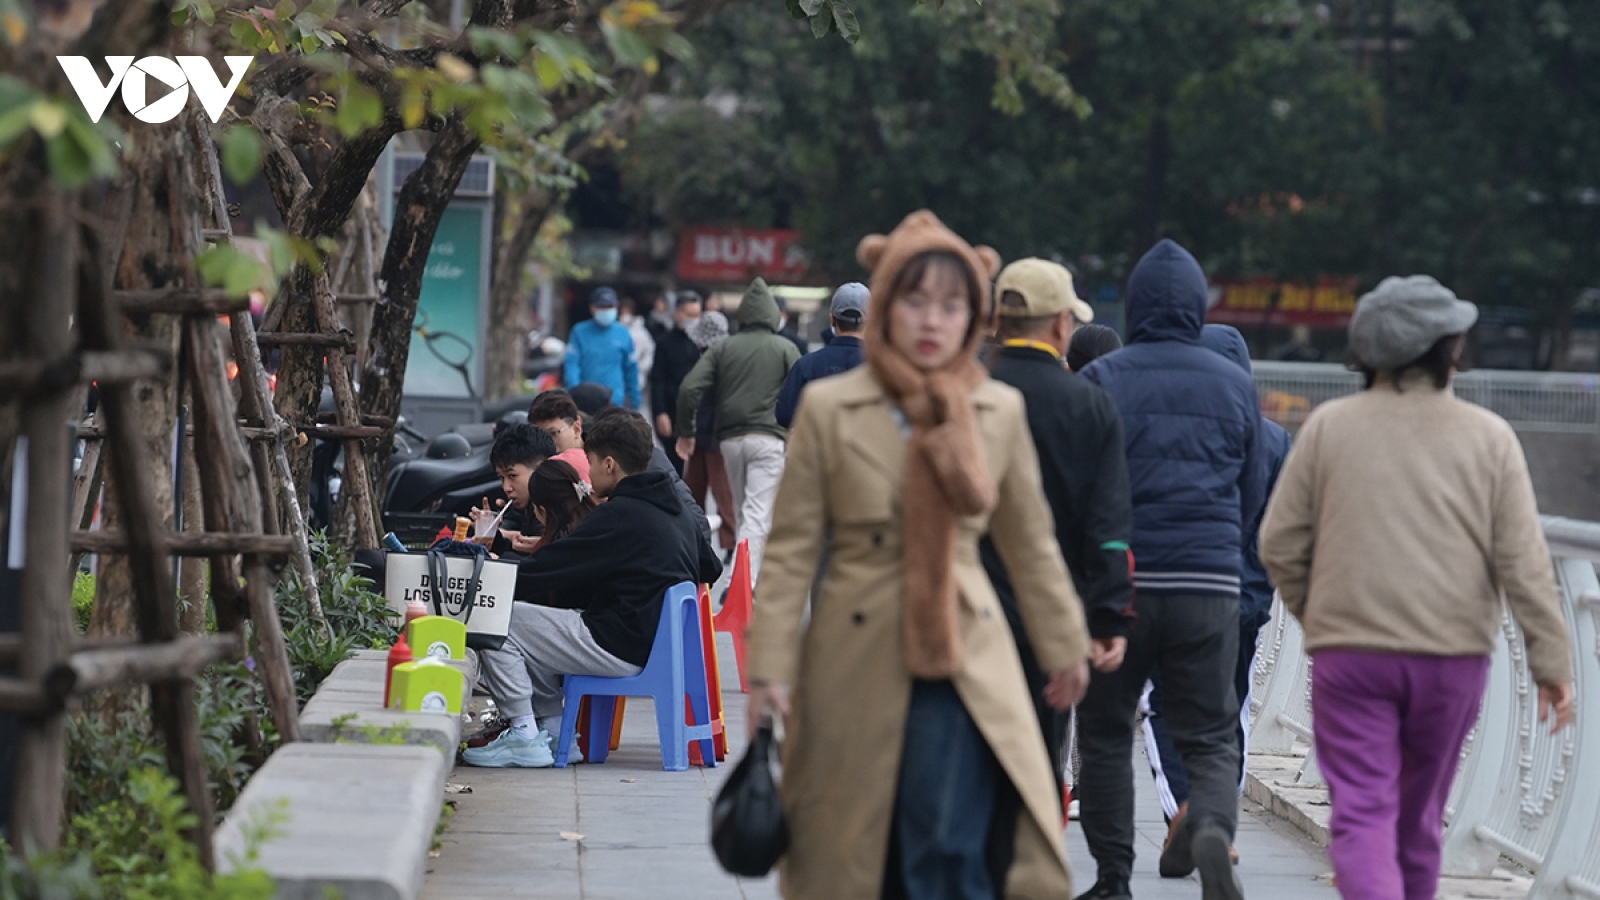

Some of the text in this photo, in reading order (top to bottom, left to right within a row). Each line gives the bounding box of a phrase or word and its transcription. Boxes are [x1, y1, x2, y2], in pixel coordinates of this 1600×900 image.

[420, 574, 483, 592] DGES
[404, 588, 496, 608] LOS NGES
